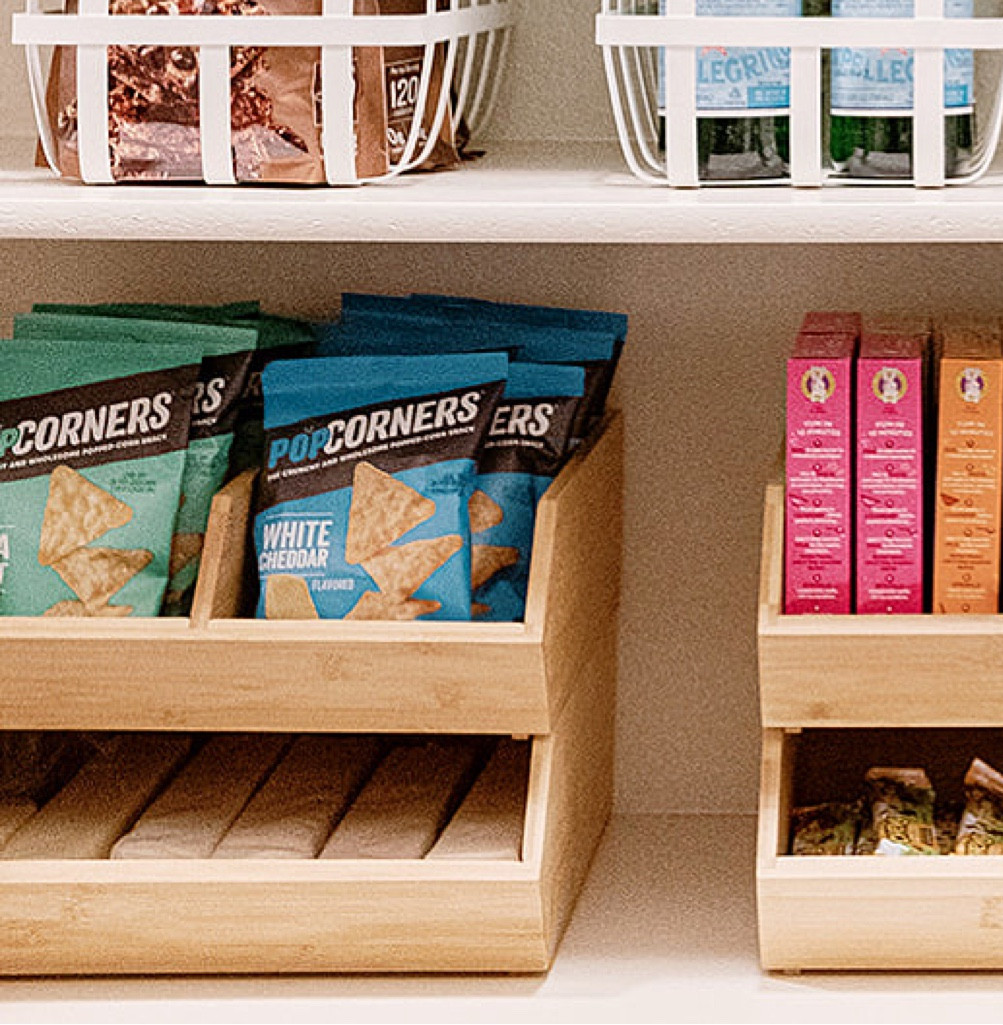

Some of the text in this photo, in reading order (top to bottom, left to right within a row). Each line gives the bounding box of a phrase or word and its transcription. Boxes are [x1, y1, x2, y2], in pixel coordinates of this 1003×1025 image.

[390, 75, 419, 109] 120
[267, 390, 482, 470] POPCORNERS
[263, 519, 334, 550] WHITE
[258, 548, 329, 571] CHEDDAR
